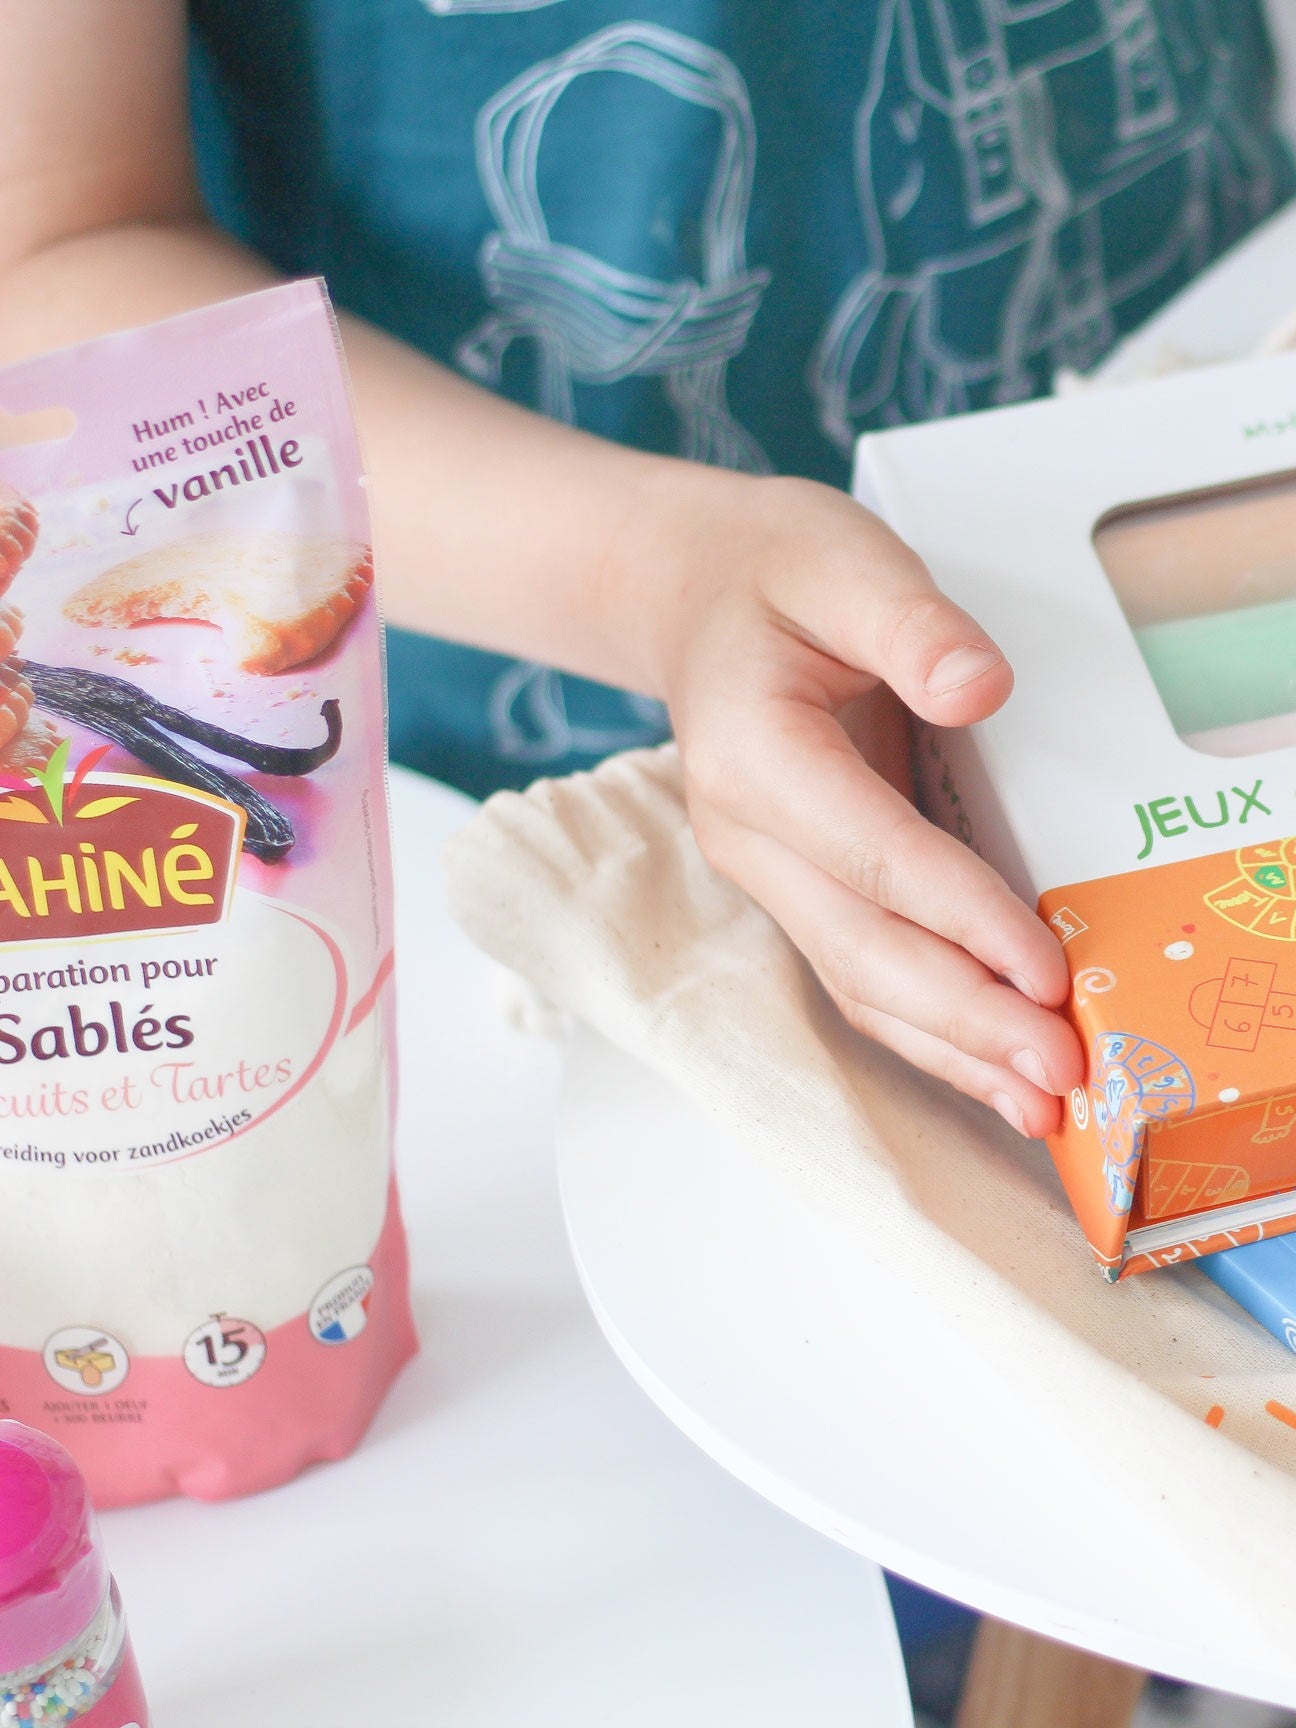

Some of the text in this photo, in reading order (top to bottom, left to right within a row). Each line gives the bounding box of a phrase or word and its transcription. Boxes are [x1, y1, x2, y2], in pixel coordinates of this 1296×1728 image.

[131, 411, 195, 443] Hum
[216, 381, 271, 415] Avec
[131, 398, 298, 473] une touche de
[152, 434, 304, 509] vanille
[1133, 779, 1272, 860] JEUX
[141, 956, 218, 988] pour
[0, 1001, 195, 1064] Sablés
[1224, 1019, 1251, 1033] 6
[1271, 1004, 1294, 1018] 5
[101, 1076, 141, 1111] et
[151, 1058, 292, 1104] Tartes
[0, 1109, 252, 1168] eiding voor zandkoekjes
[196, 1327, 248, 1367] 15
